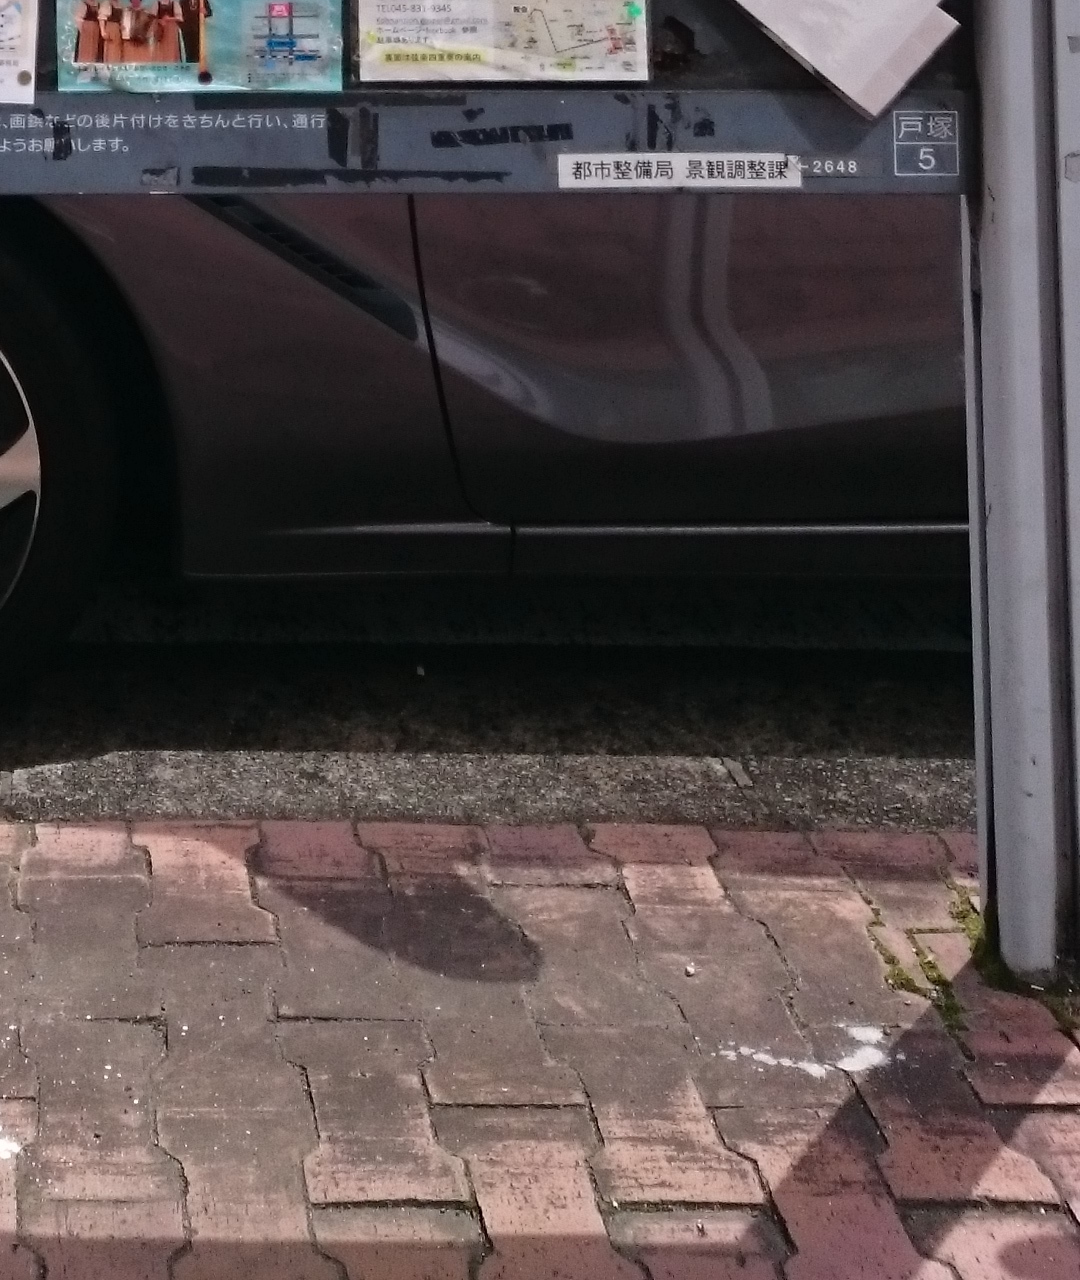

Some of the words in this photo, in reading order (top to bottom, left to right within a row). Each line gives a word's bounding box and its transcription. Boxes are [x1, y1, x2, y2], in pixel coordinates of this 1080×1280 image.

[897, 114, 956, 140] 戸塚
[571, 158, 675, 181] 都市整備局
[685, 158, 789, 181] 景観調整課
[917, 147, 937, 171] 5
